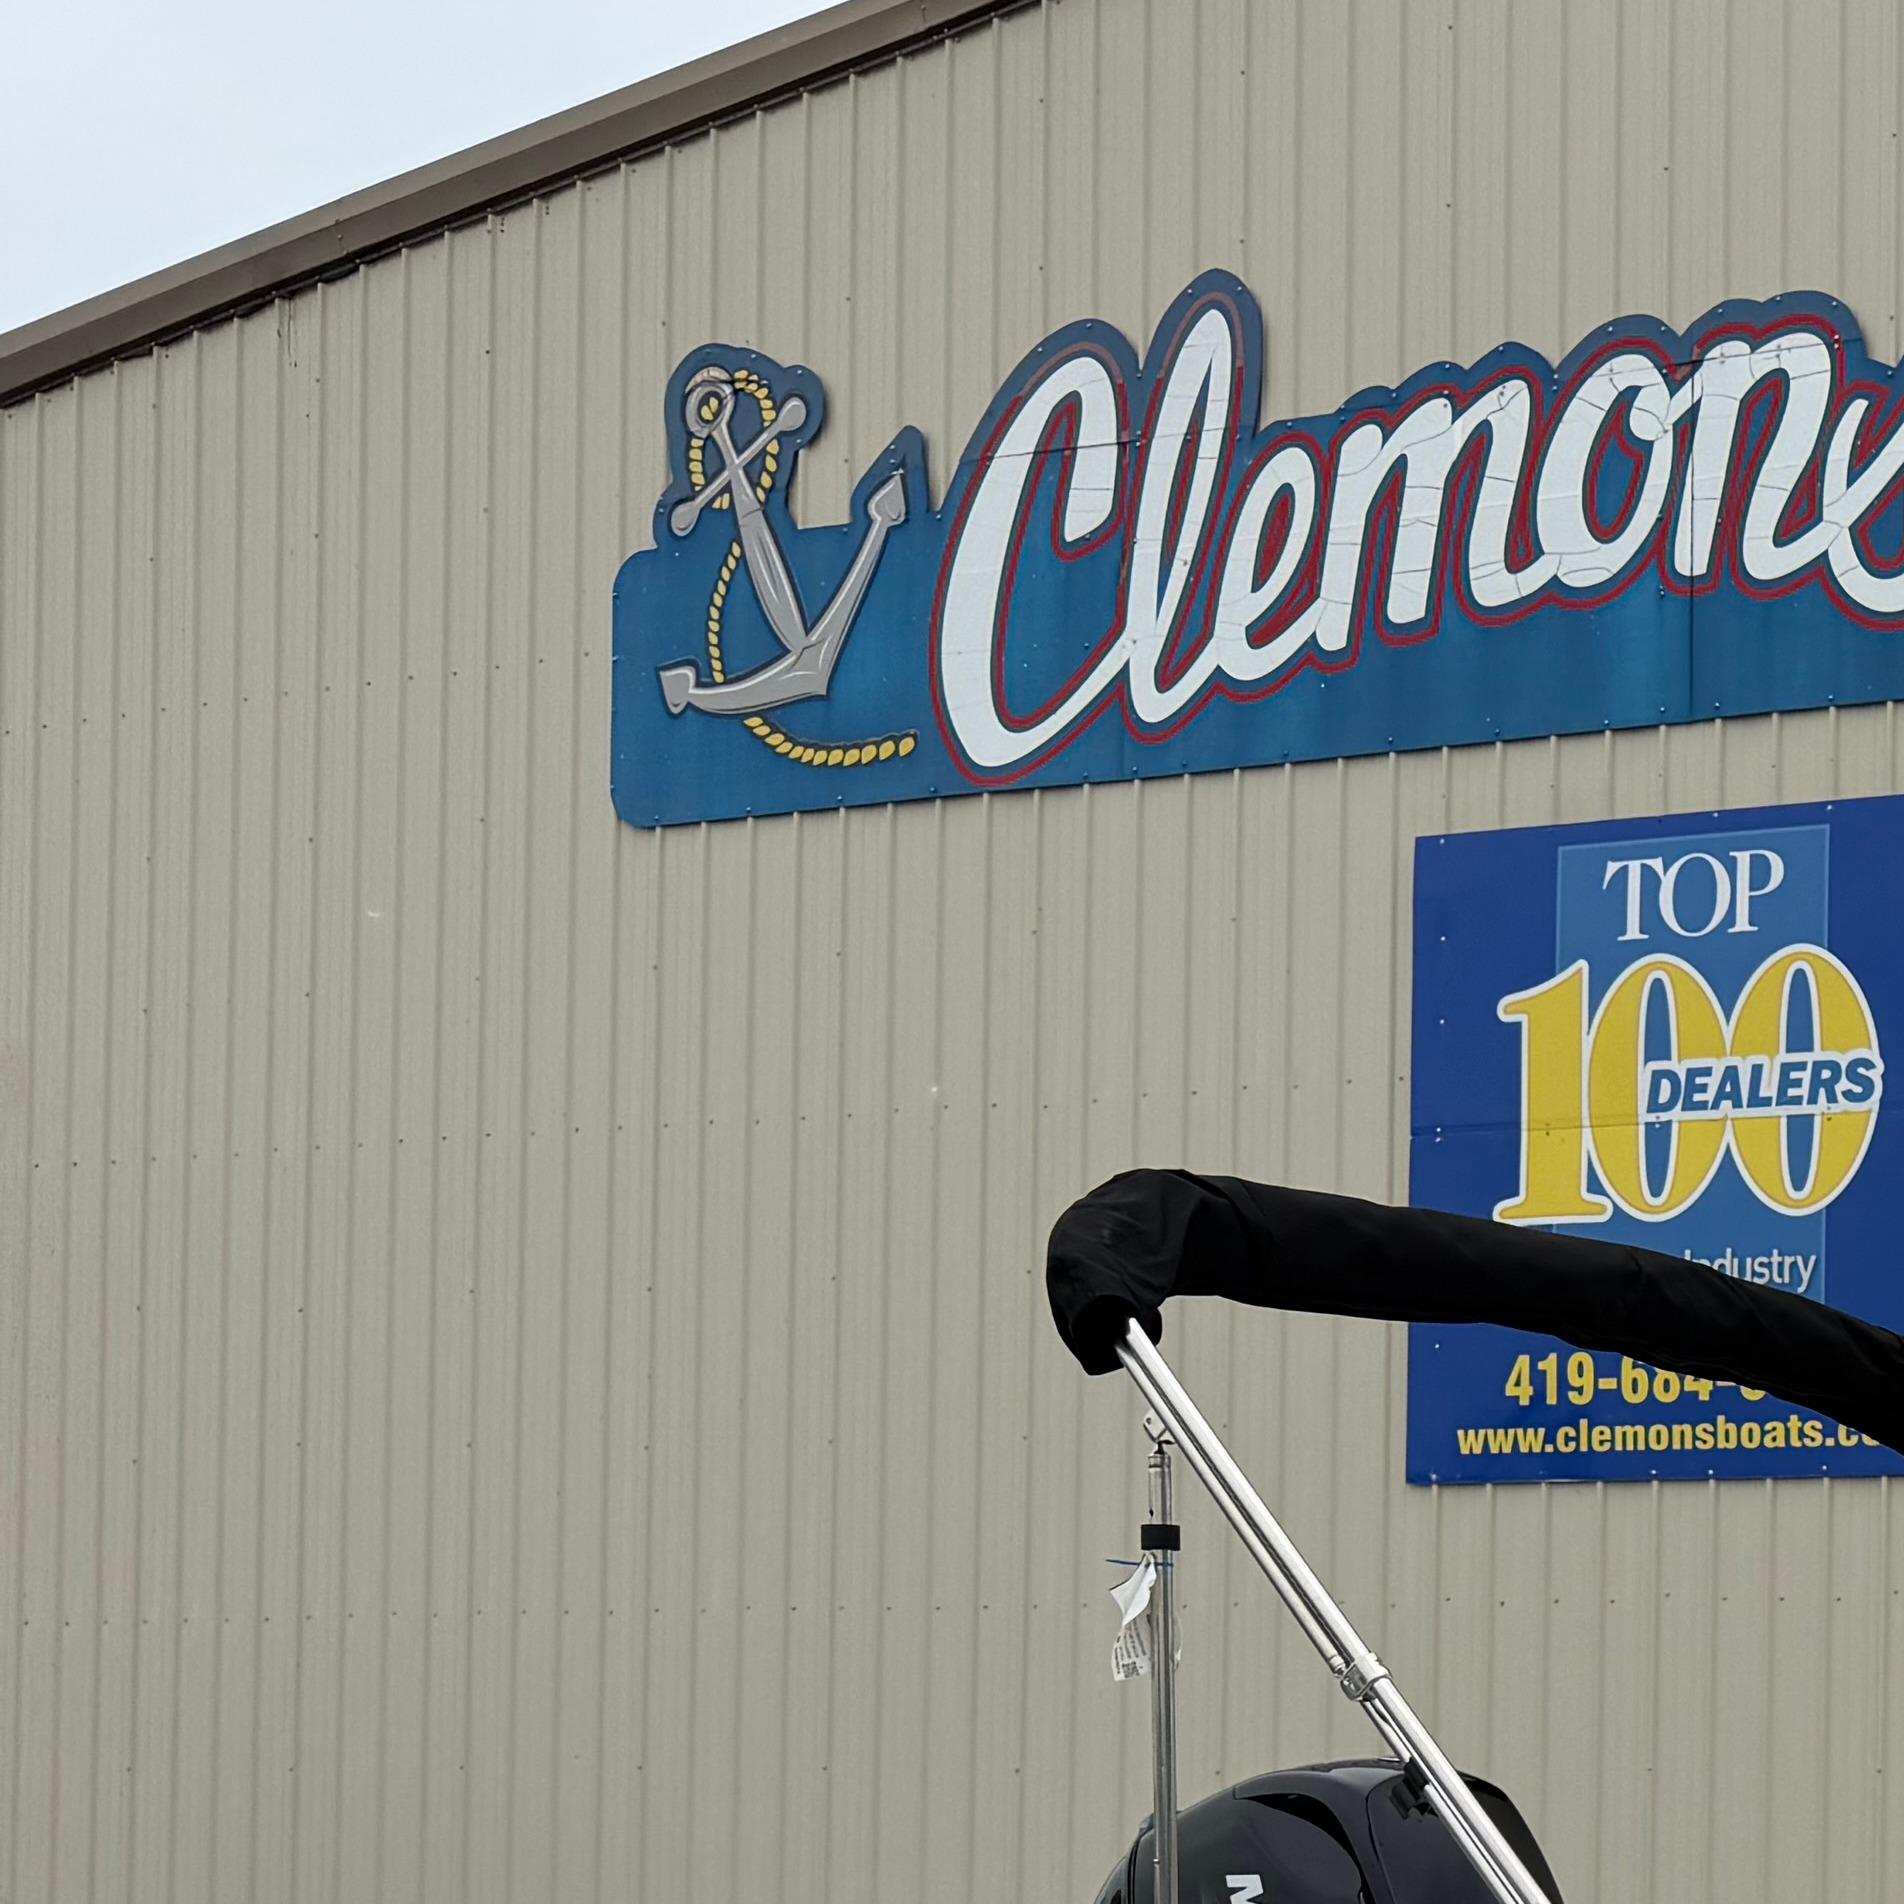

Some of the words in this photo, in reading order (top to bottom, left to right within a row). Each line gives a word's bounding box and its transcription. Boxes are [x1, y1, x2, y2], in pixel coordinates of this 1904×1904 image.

[1603, 849, 1785, 941] TOP
[1493, 943, 1880, 1223] 100
[1647, 1057, 1876, 1113] DEALERS
